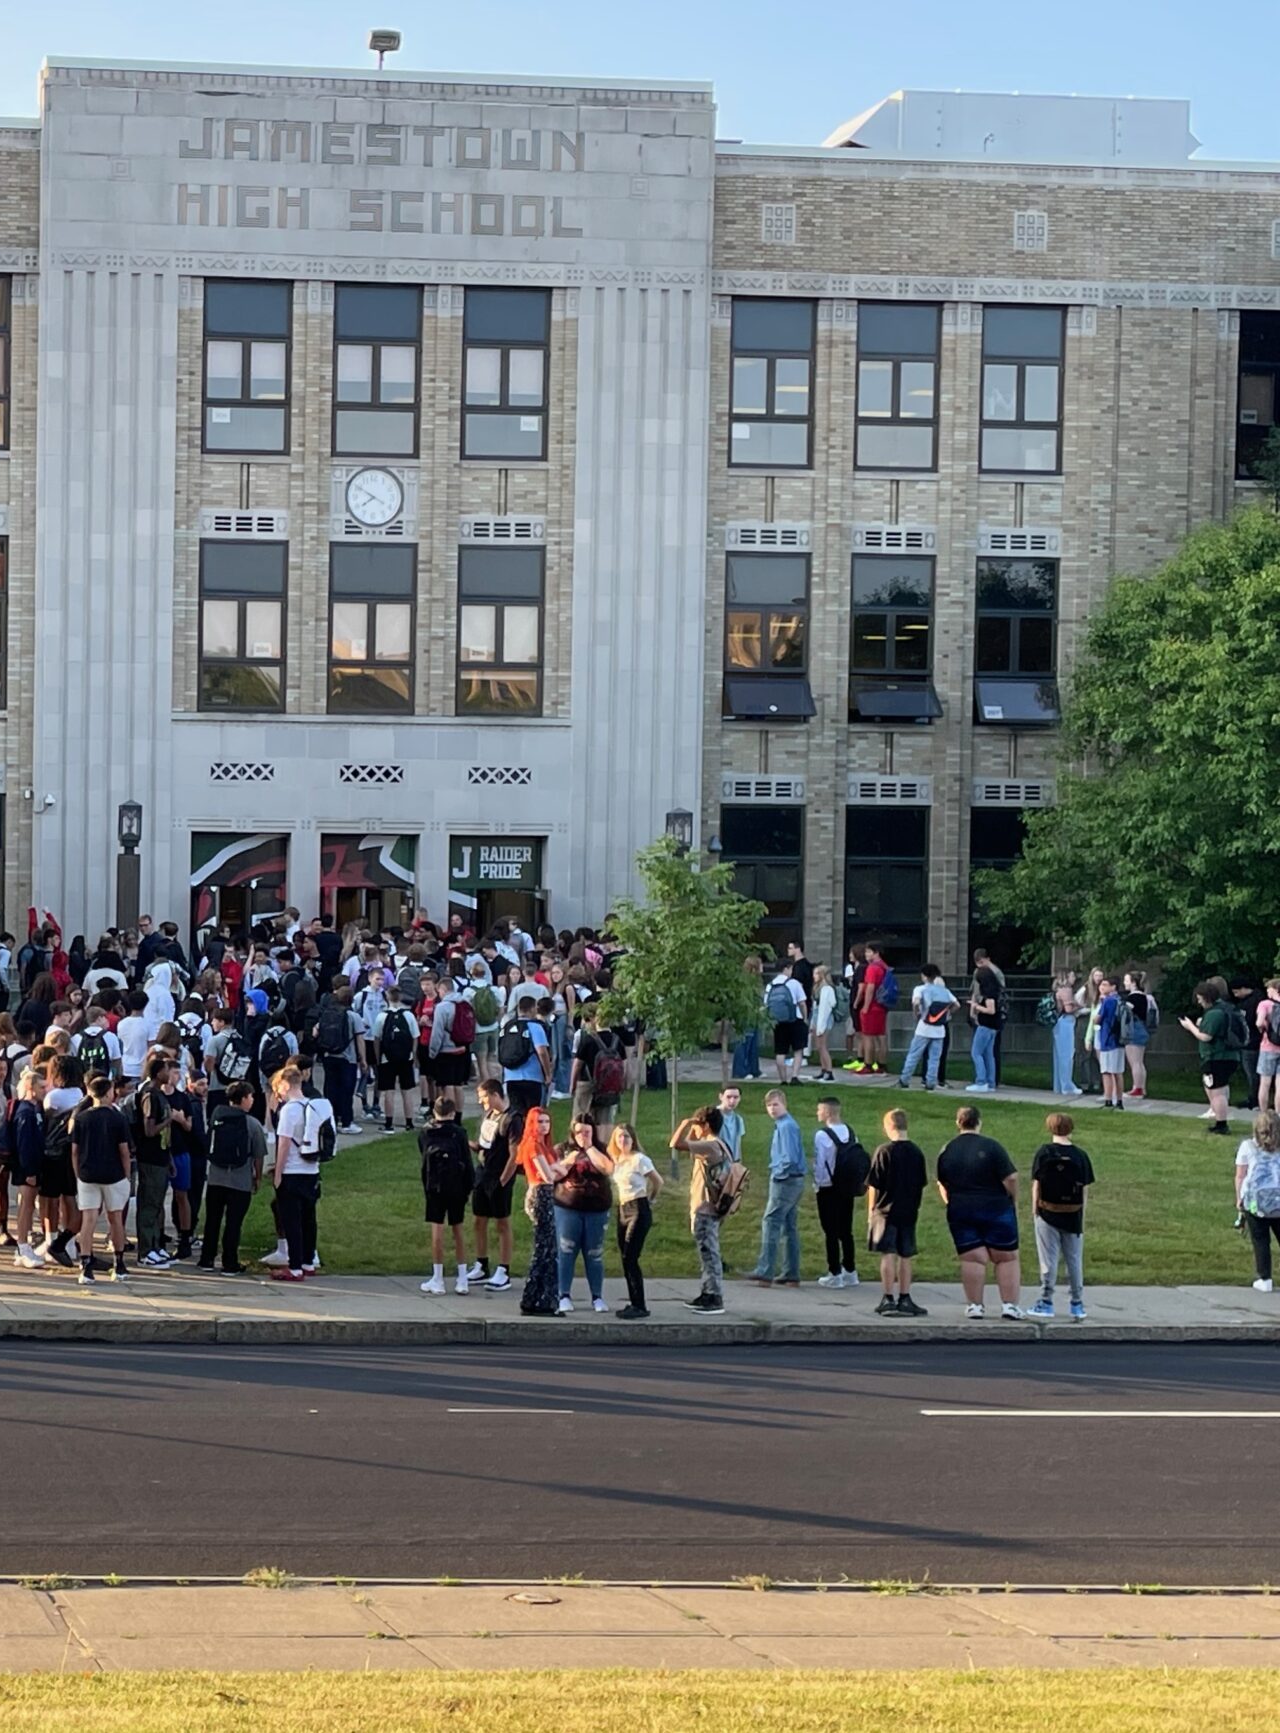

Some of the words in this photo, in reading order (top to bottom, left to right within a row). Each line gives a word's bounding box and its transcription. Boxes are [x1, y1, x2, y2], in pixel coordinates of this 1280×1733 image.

[178, 117, 585, 172] JAMESTOWN
[176, 183, 309, 229] HIGH
[349, 188, 584, 237] SCHOOL
[452, 846, 472, 878] J
[479, 846, 532, 862] RAIDER
[479, 863, 522, 879] PRIDE
